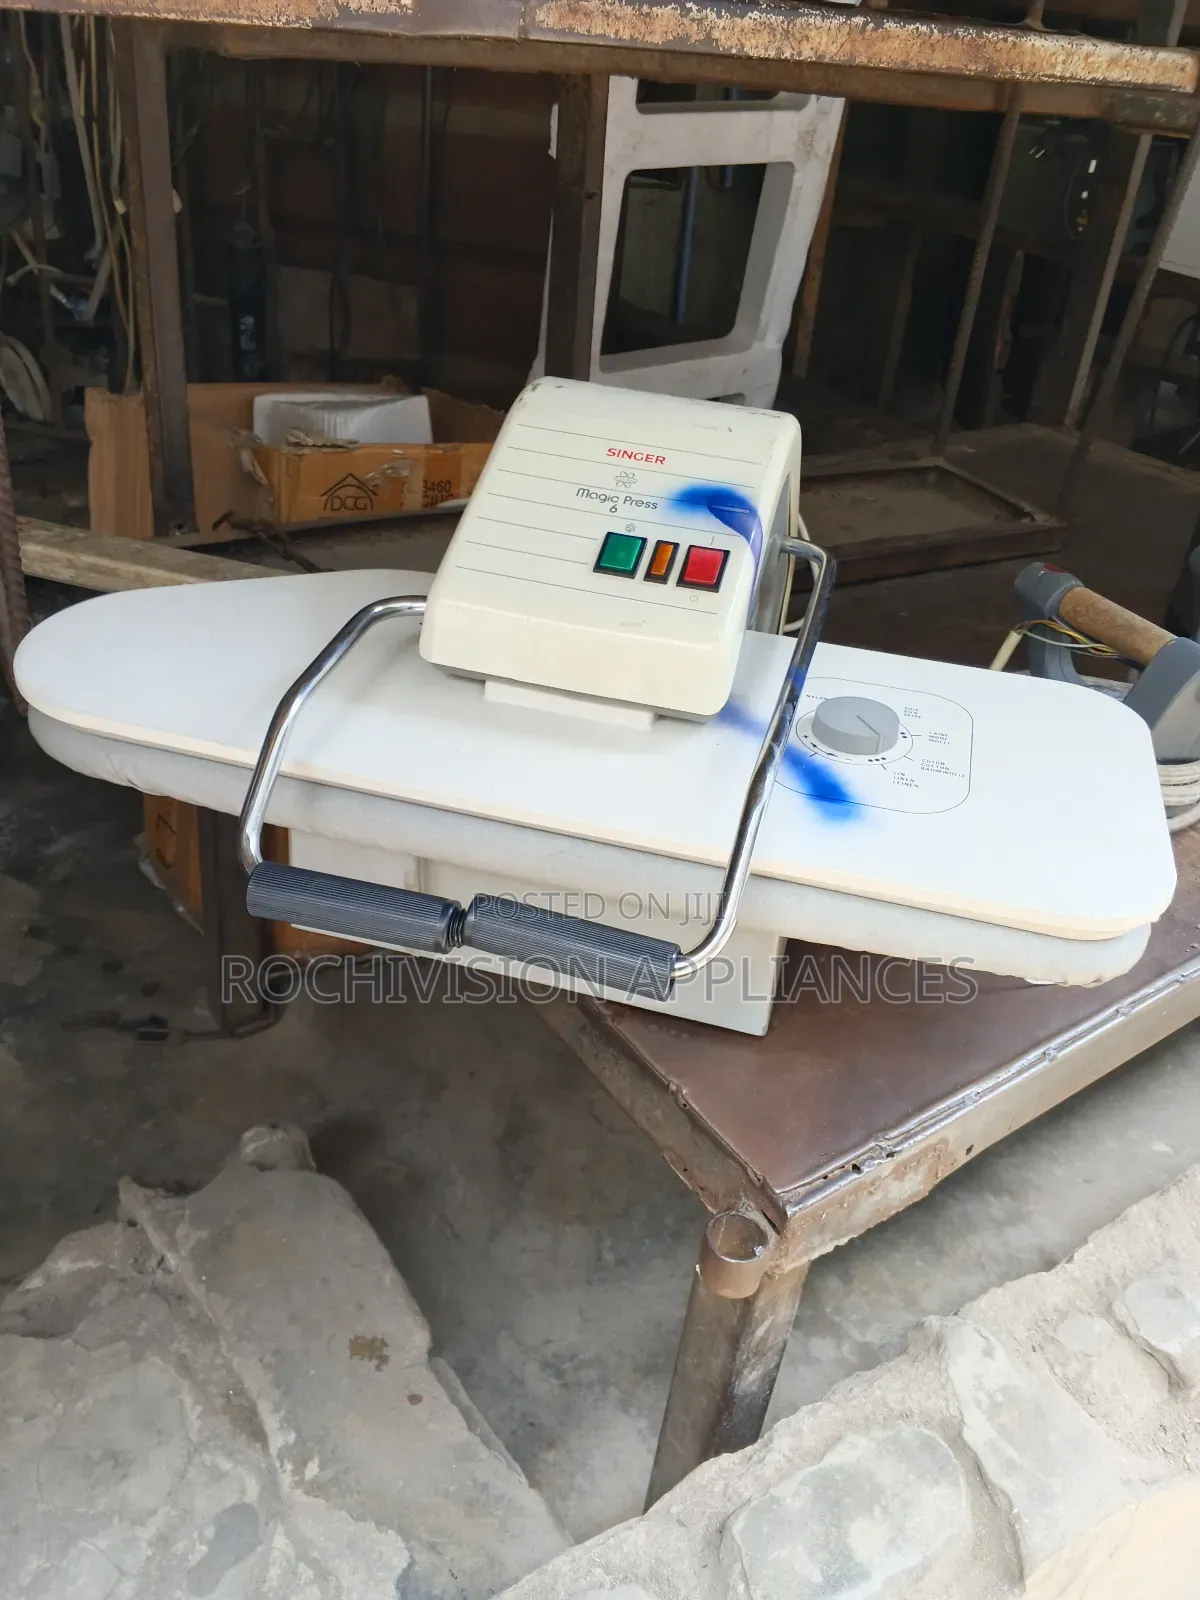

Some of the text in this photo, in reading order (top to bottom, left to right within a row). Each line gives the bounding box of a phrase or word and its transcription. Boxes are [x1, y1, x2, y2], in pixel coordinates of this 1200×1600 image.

[606, 447, 666, 465] SINGER
[575, 487, 658, 510] Magic Press
[609, 504, 618, 514] 6
